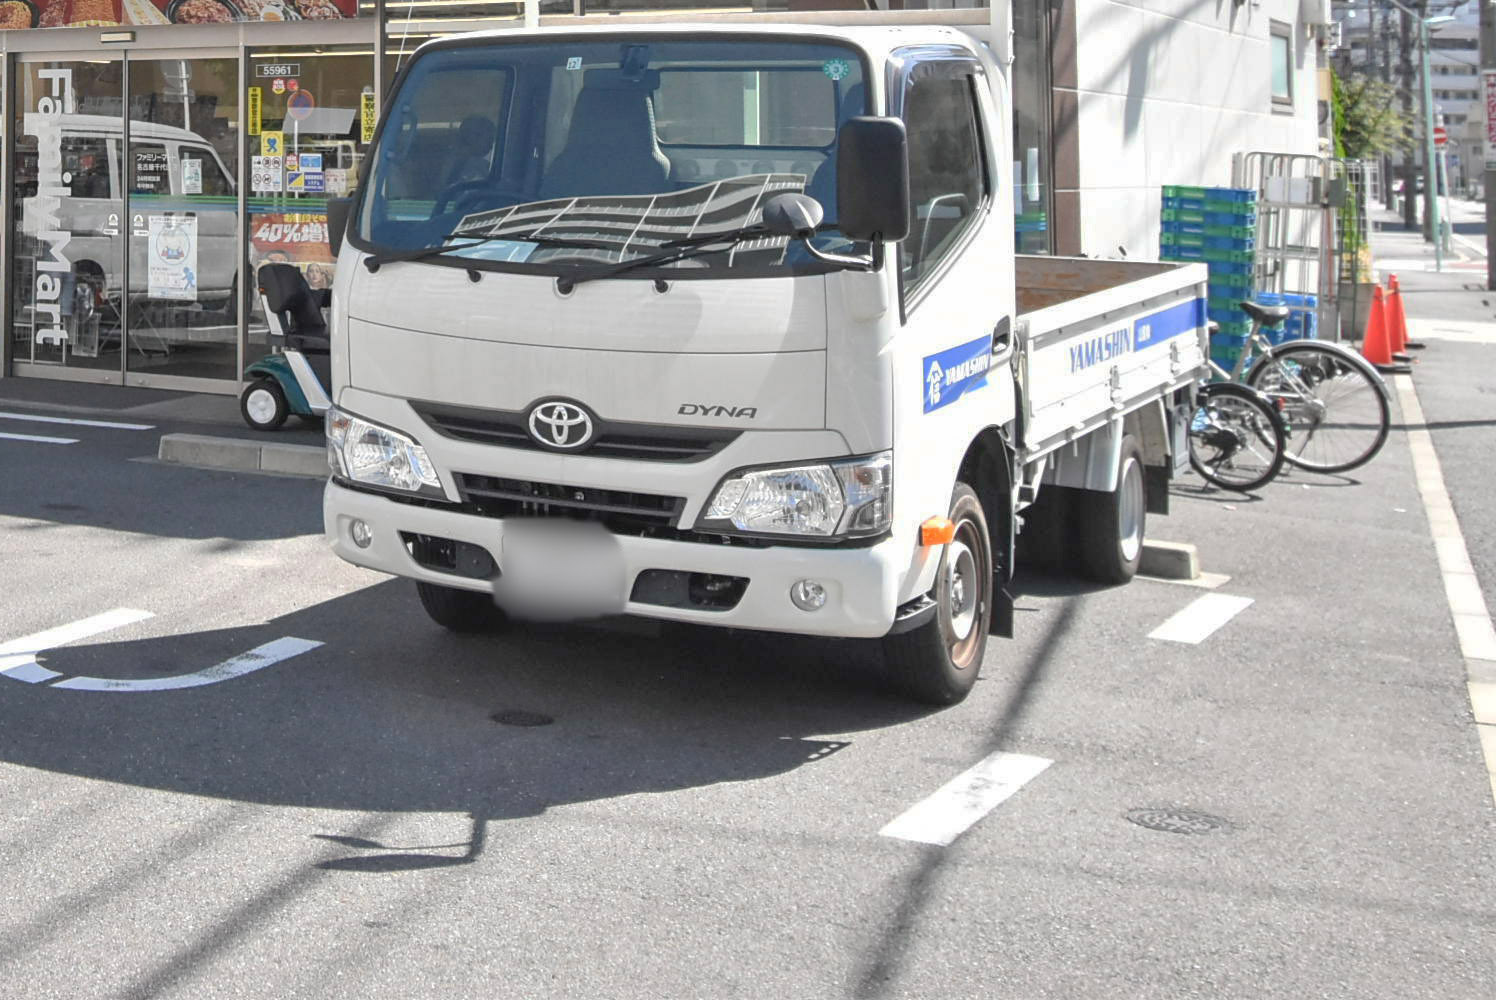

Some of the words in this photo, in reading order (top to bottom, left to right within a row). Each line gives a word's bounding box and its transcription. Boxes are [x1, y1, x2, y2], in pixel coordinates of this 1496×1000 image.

[263, 66, 291, 75] 55961
[1070, 328, 1130, 373] YAMASHIN
[946, 353, 990, 386] YAMASHIN
[677, 404, 757, 419] DYNA
